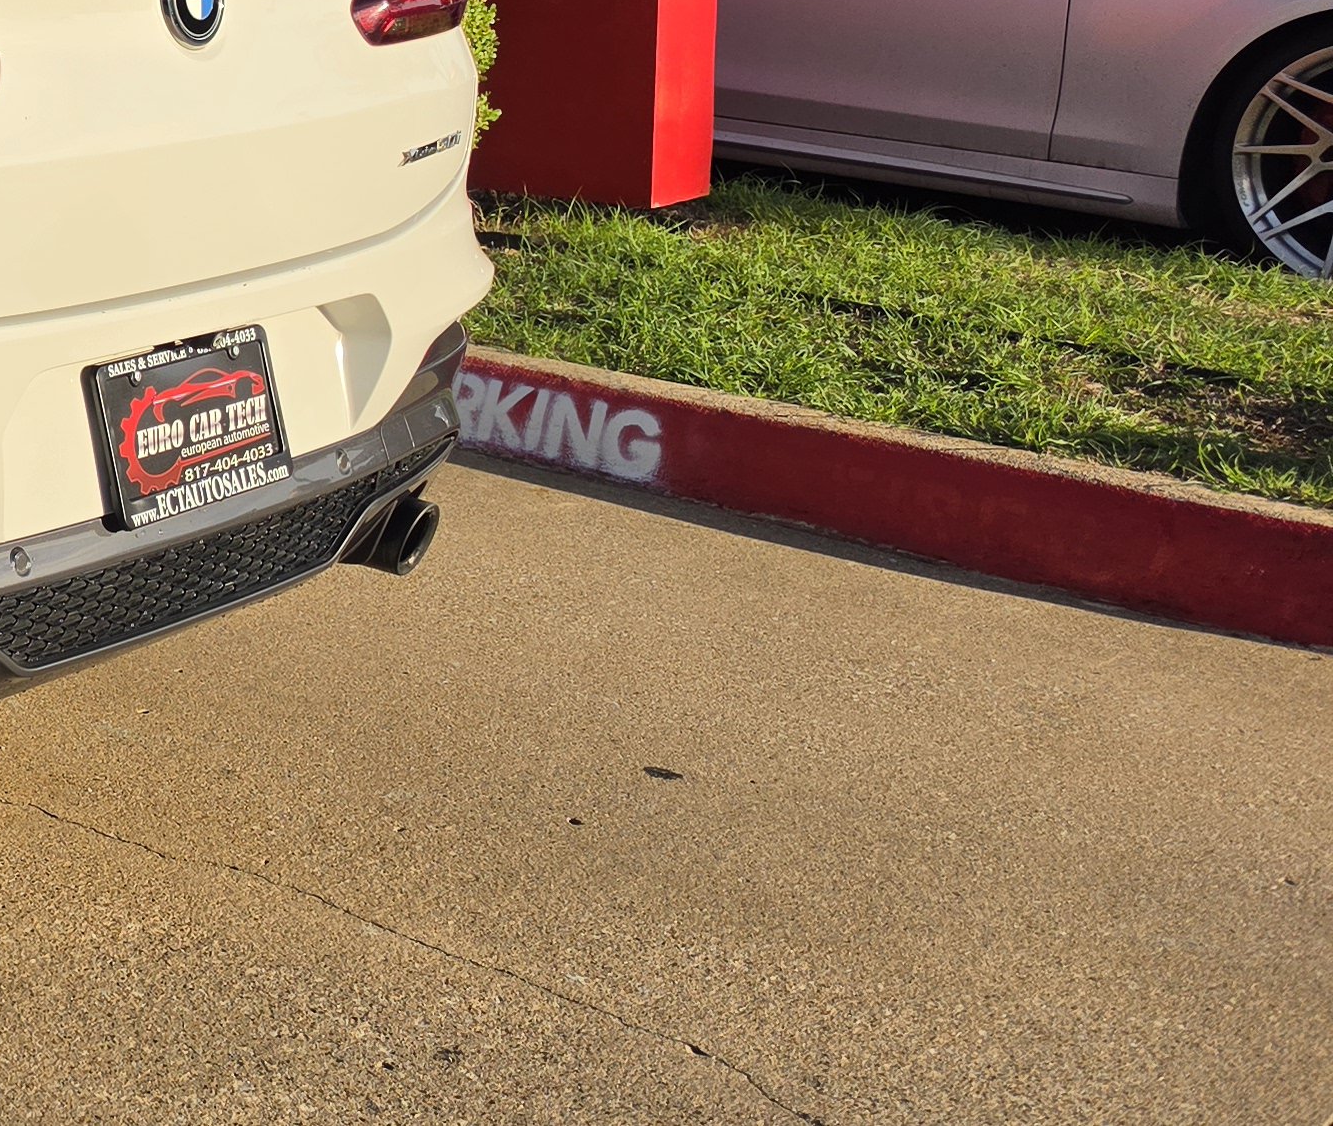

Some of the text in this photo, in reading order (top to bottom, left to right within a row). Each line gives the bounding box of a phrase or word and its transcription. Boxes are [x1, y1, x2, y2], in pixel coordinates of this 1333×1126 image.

[107, 362, 137, 378] SALES
[137, 357, 147, 371] &
[136, 394, 268, 460] EURO CAR TECH
[181, 421, 270, 458] european automotive
[452, 373, 663, 482] RKING
[184, 442, 274, 483] 817-404-4033
[130, 461, 290, 528] www.ECTAUTOSALES.com
